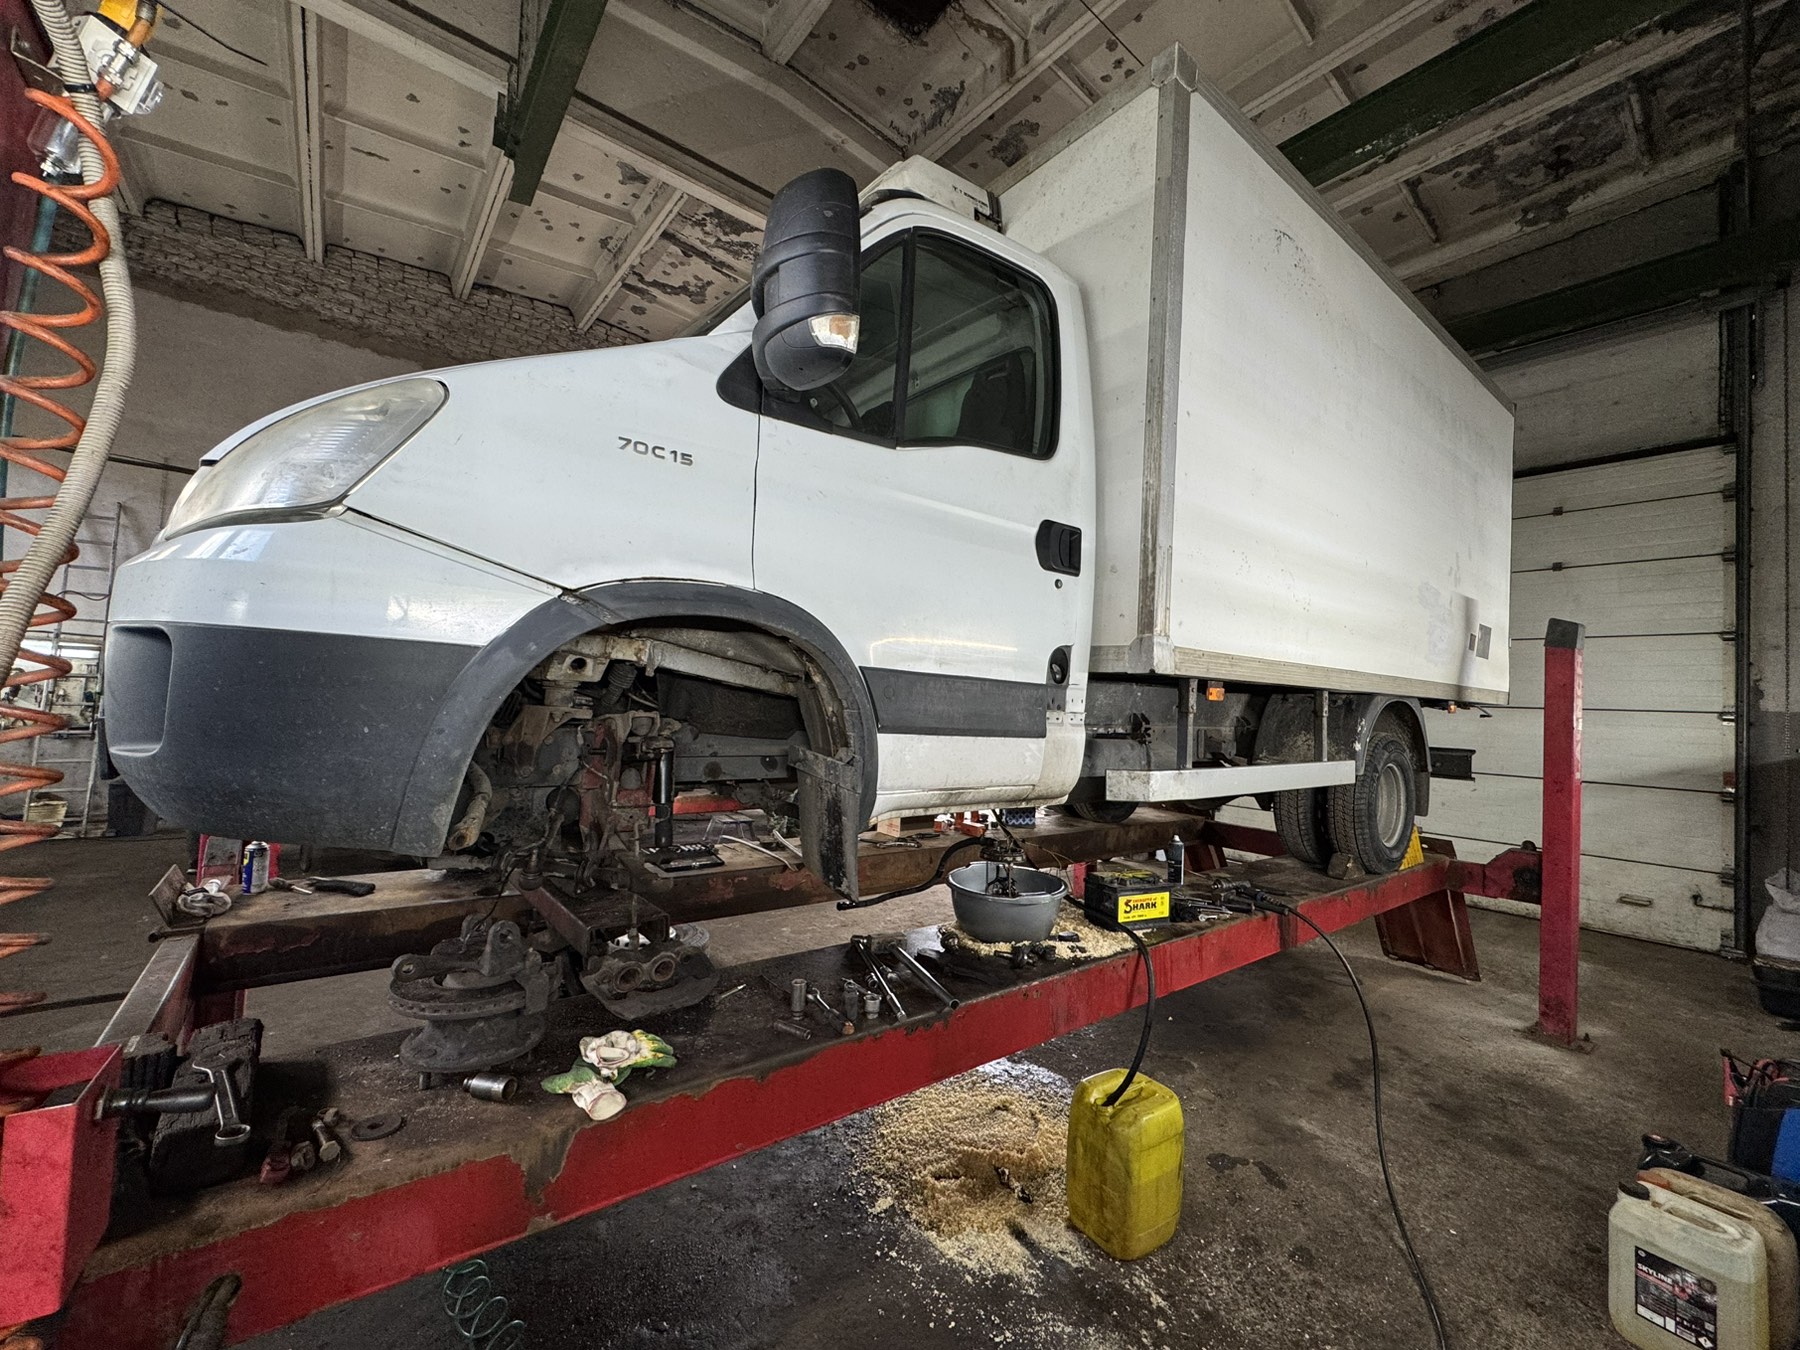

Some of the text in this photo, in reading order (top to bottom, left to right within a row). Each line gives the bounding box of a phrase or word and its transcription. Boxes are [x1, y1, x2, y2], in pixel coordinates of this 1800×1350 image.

[618, 436, 693, 466] 70C15
[1123, 899, 1157, 914] SHARK
[1637, 1262, 1673, 1285] SKYLINE
